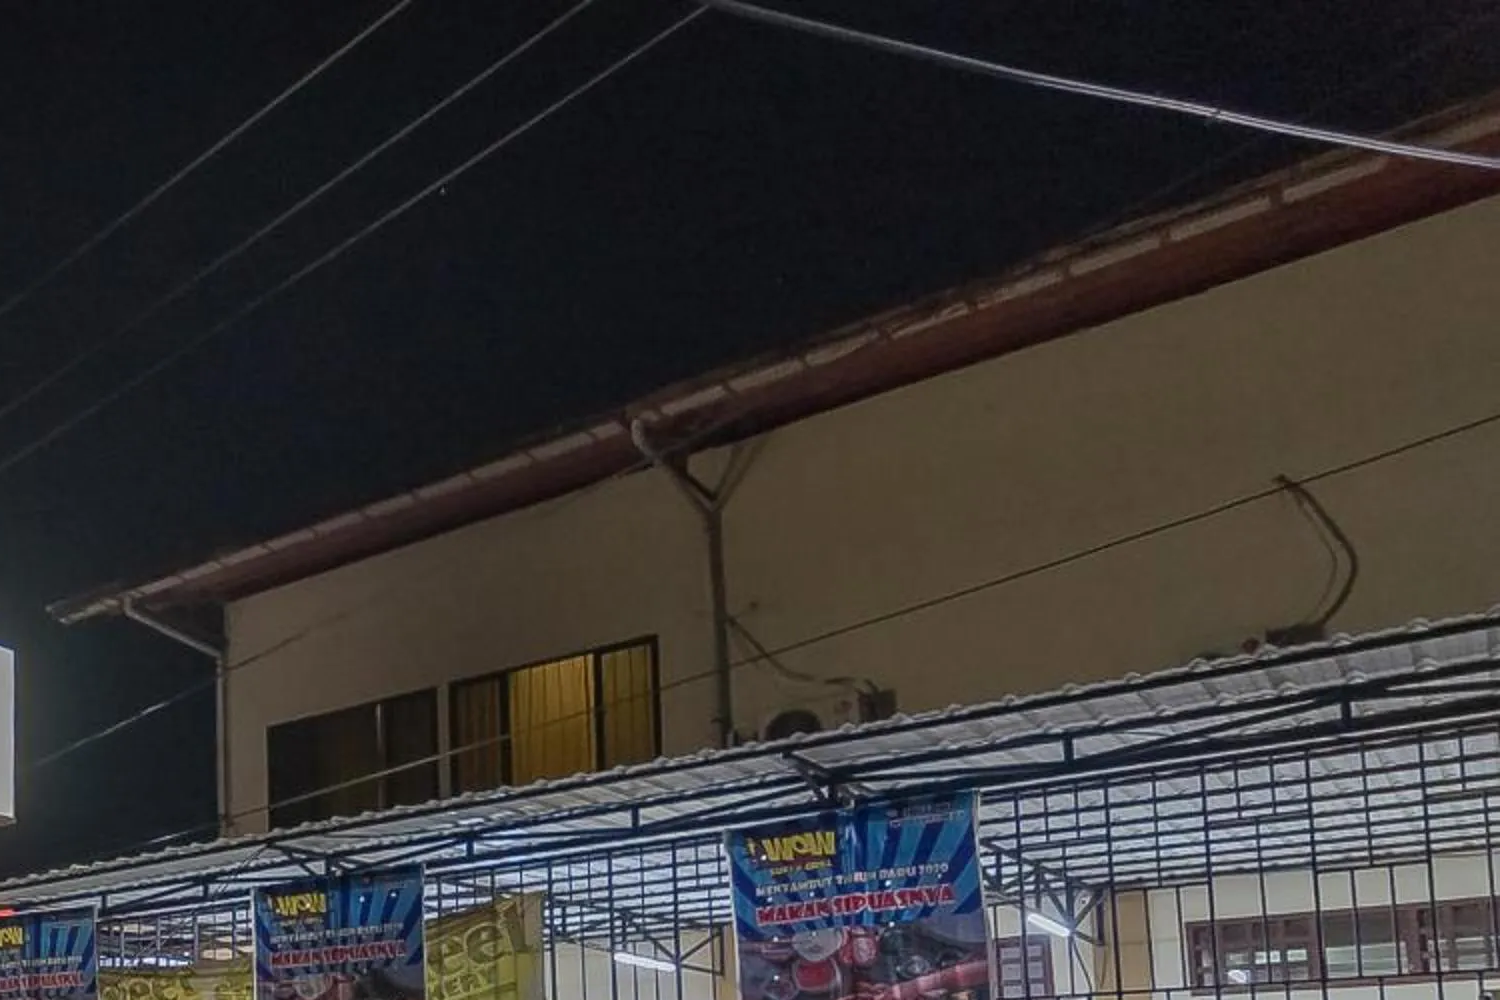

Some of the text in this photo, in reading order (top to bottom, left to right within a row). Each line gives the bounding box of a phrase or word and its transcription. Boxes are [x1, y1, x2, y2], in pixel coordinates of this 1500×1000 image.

[763, 831, 836, 862] WOW
[878, 864, 916, 880] BARU
[274, 892, 327, 917] WOW
[755, 897, 830, 927] MAKAN
